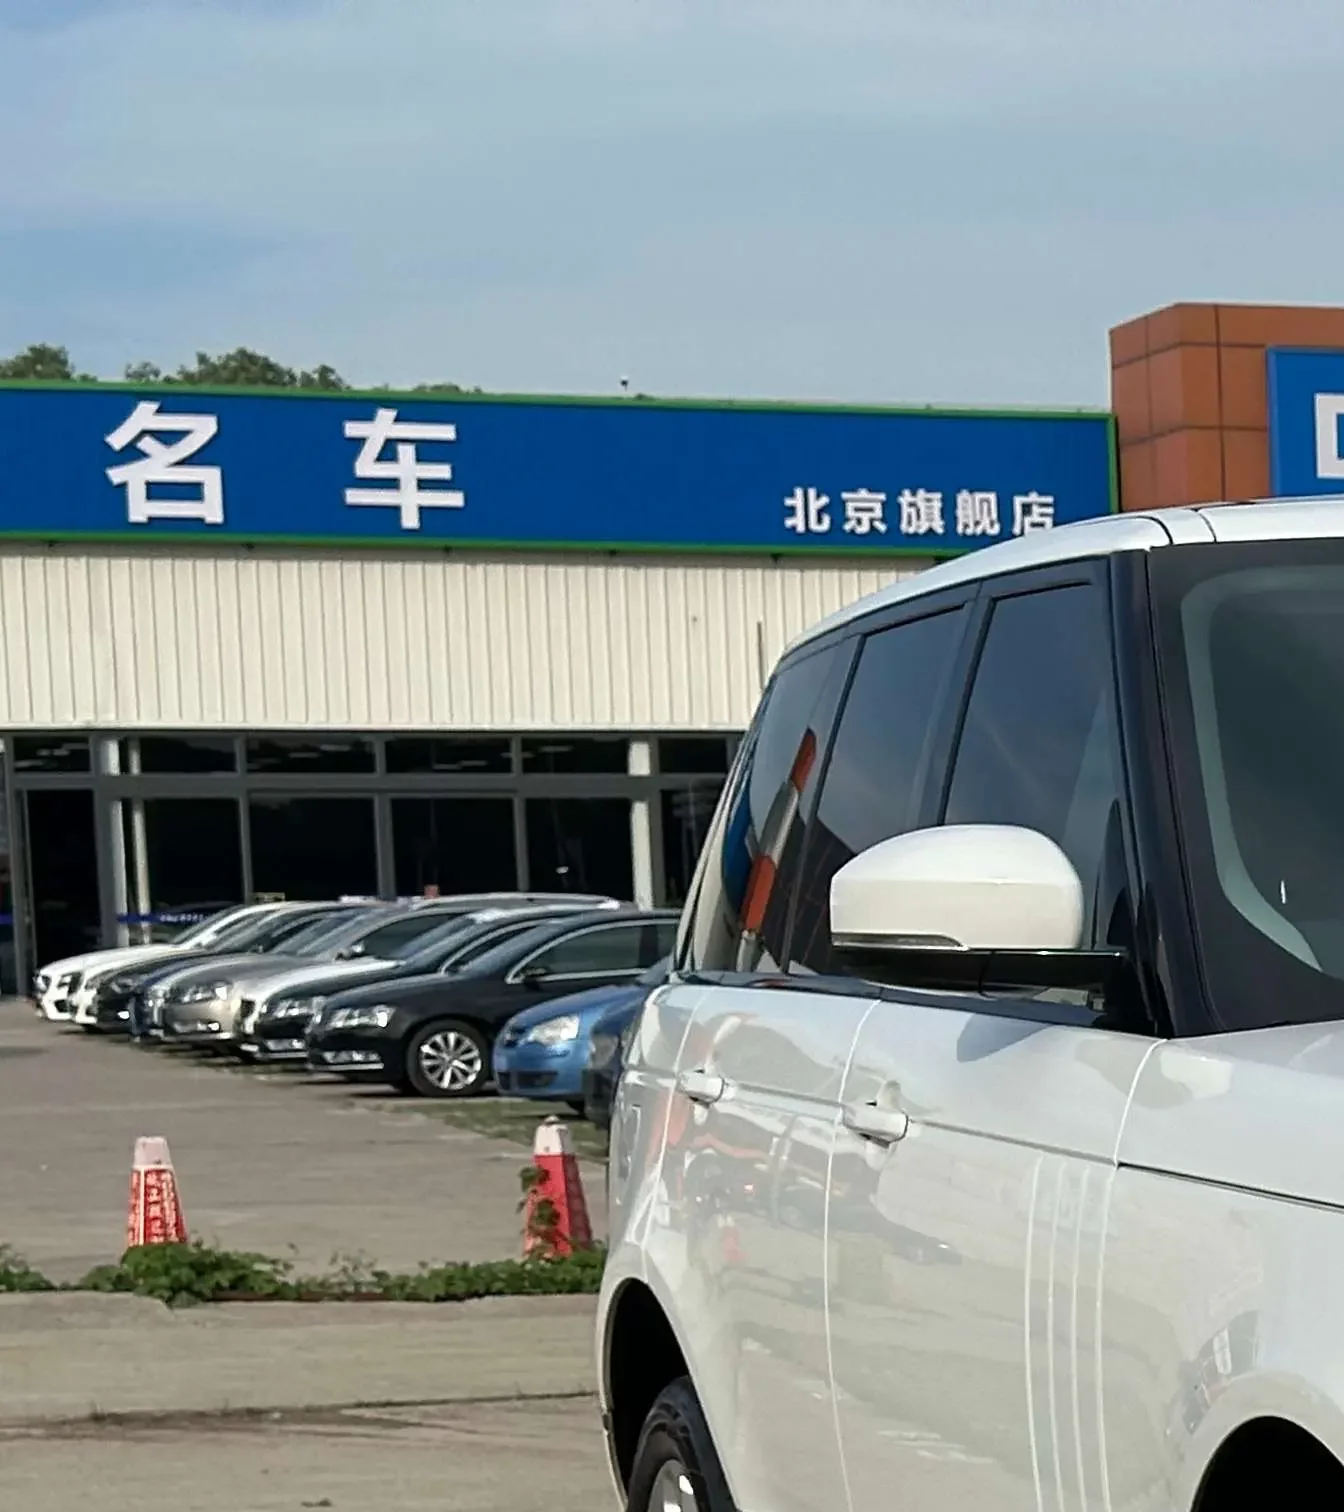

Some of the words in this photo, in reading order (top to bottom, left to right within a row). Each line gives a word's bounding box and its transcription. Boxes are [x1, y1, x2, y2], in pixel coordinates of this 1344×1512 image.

[104, 400, 465, 530] 名车
[783, 487, 1055, 536] 北京旗舰店
